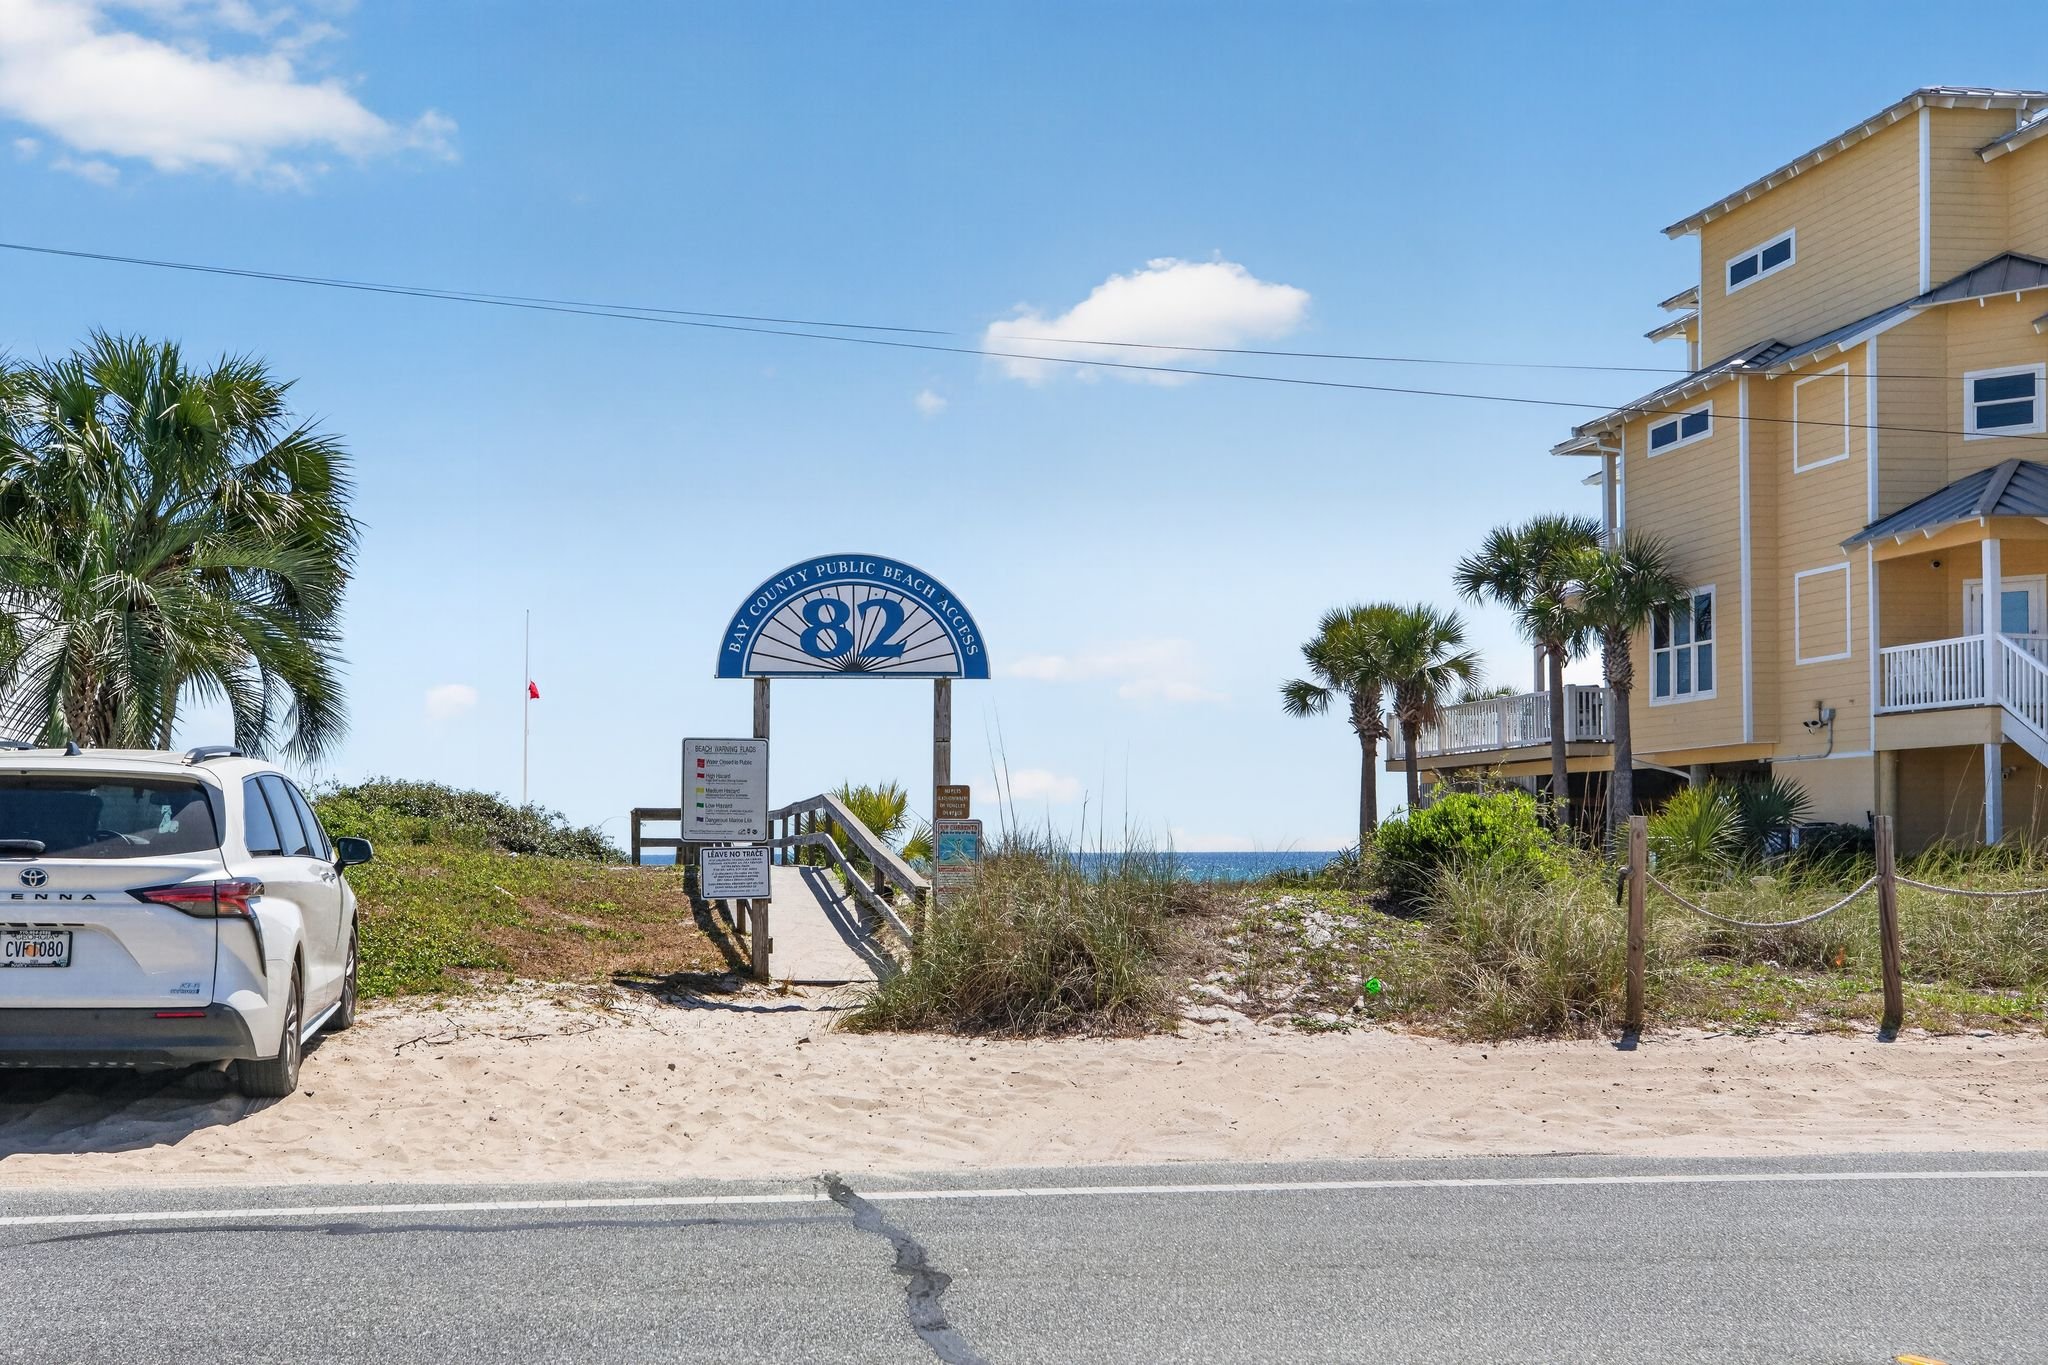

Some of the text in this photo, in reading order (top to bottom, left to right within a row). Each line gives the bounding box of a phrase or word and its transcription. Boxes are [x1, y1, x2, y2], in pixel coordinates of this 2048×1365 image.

[728, 560, 980, 657] BAY COUNTY PUBLIC BEACH ACCESS
[799, 597, 908, 659] 82
[694, 745, 713, 753] BEACH
[714, 745, 738, 753] WARNING
[740, 745, 757, 753] FLAGS
[707, 850, 728, 858] LEAVE
[742, 849, 764, 857] TRACE
[10, 893, 97, 901] ENNA
[5, 940, 64, 958] CVF1080
